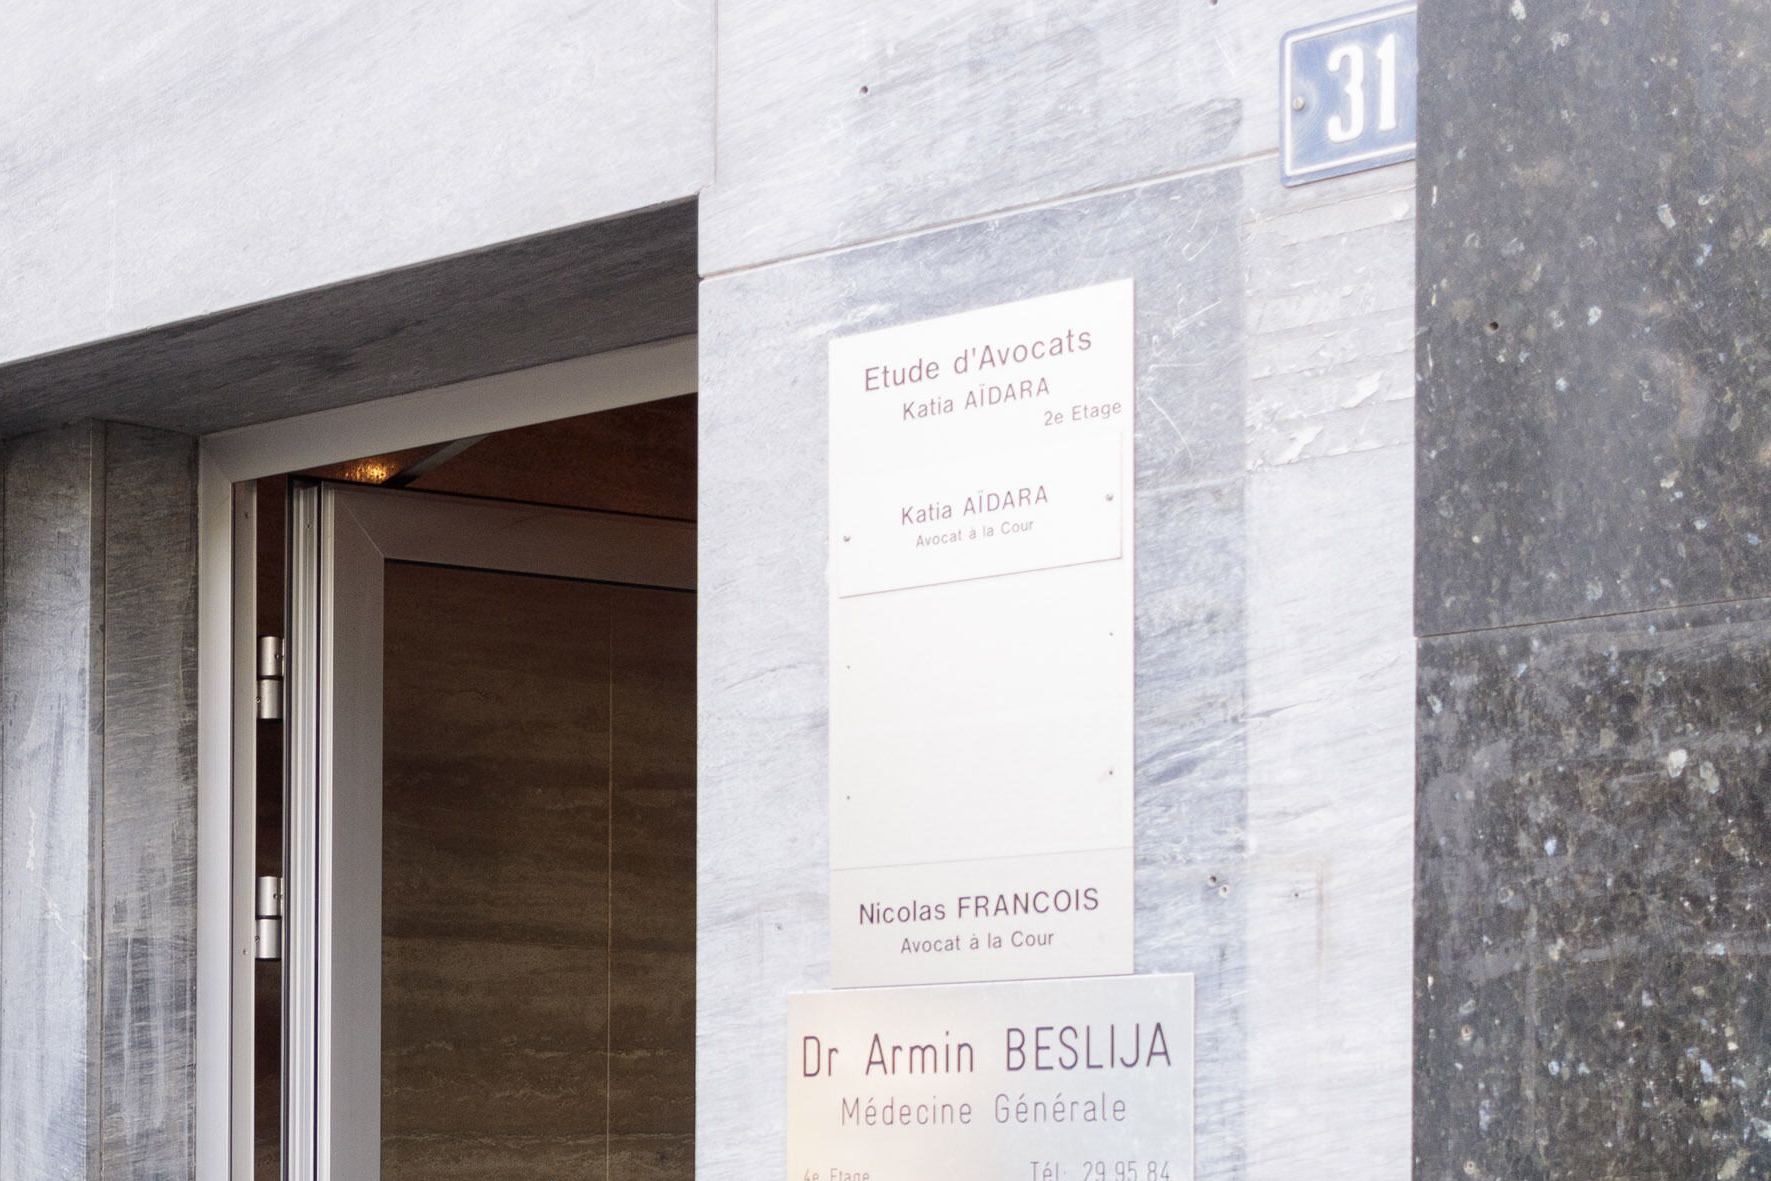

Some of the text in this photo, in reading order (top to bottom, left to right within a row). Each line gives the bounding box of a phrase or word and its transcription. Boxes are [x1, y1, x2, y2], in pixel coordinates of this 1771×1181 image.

[1327, 33, 1397, 143] 31
[865, 329, 1092, 391] Etude d'Avocats
[903, 376, 1050, 421] Katia AÏDARA
[1043, 401, 1122, 427] 2e Etage
[901, 484, 1049, 526] Katia AÏDARA
[915, 518, 1034, 547] Avocat à la Cour
[859, 899, 946, 926] Nicolas
[901, 929, 1054, 955] Avocat à la Cour
[802, 1021, 1172, 1078] Dr Armin BESLIJA
[841, 1091, 1128, 1127] Médecine Générale
